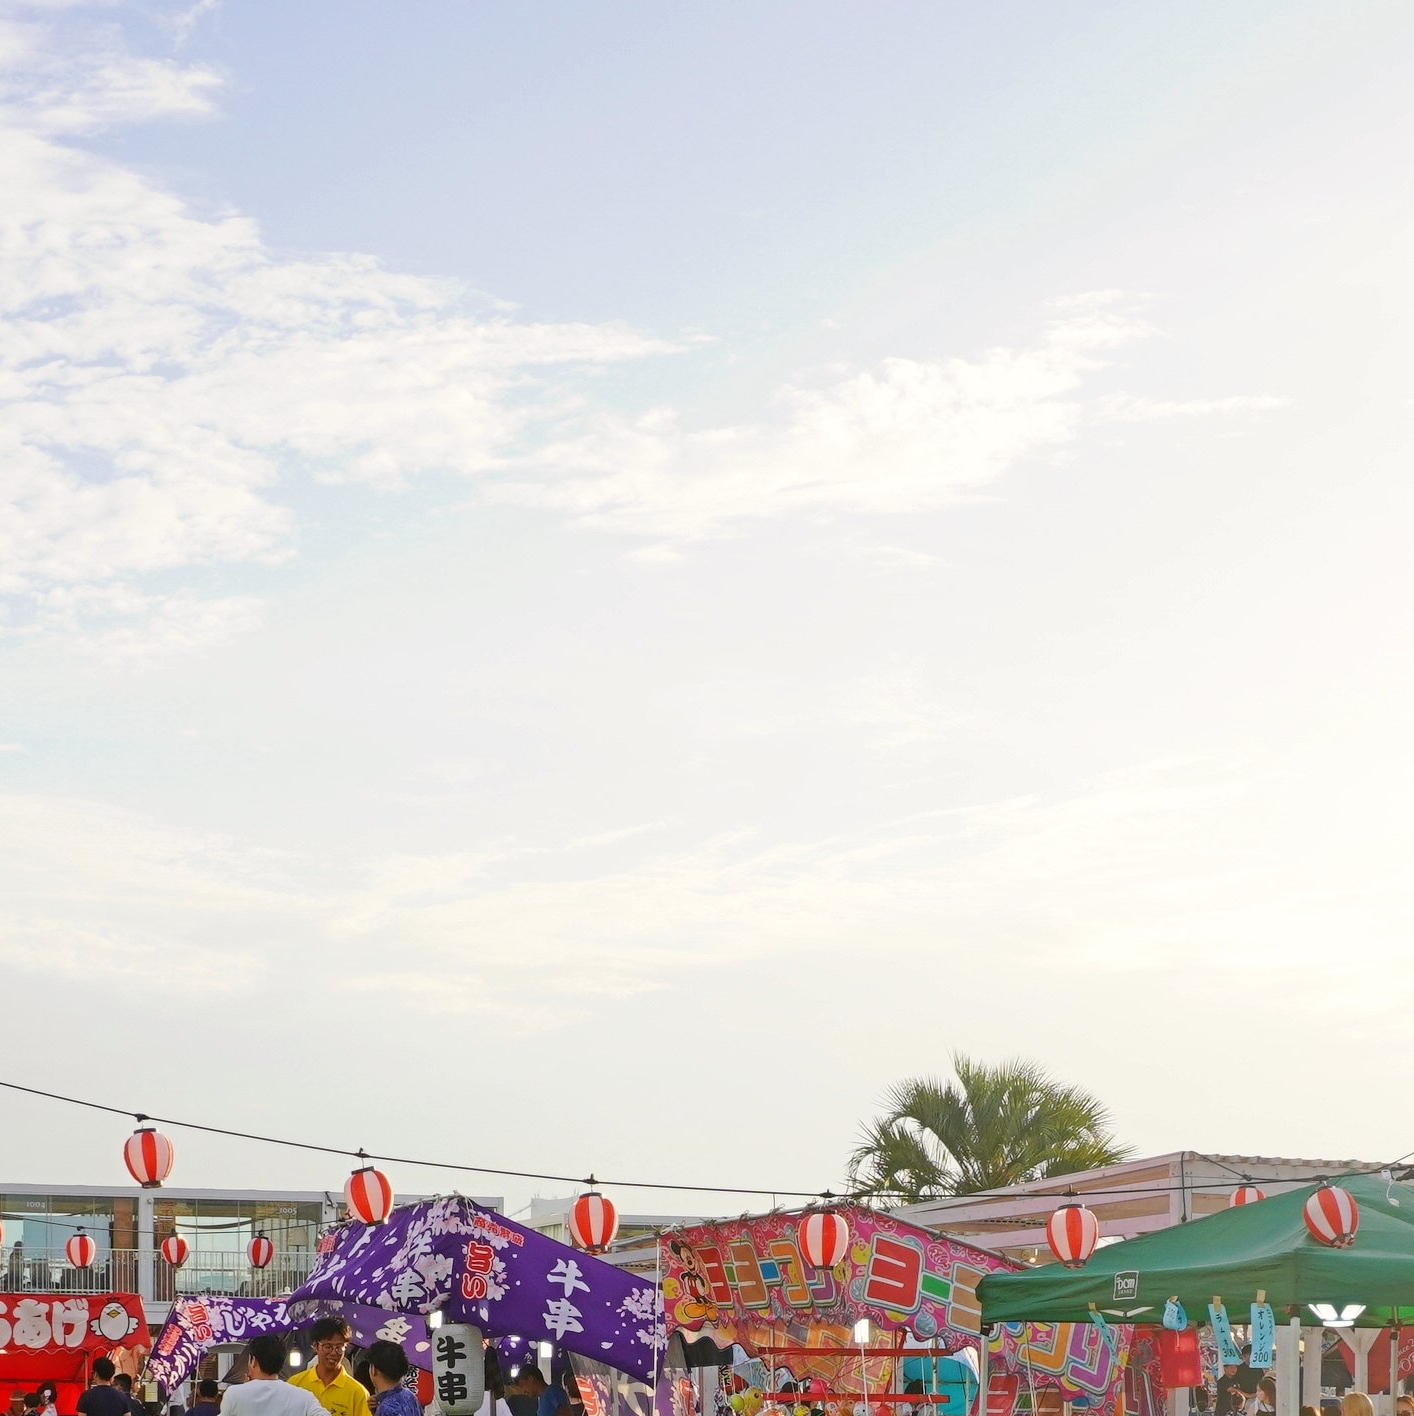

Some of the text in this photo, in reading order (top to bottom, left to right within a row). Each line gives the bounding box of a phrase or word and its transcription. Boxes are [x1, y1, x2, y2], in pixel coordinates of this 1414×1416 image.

[25, 1200, 47, 1210] 1004
[462, 1240, 495, 1300] 旨い
[542, 1257, 591, 1341] 牛串
[1257, 1309, 1266, 1352] オレンジ
[436, 1335, 468, 1406] 牛串
[1252, 1351, 1269, 1363] 300
